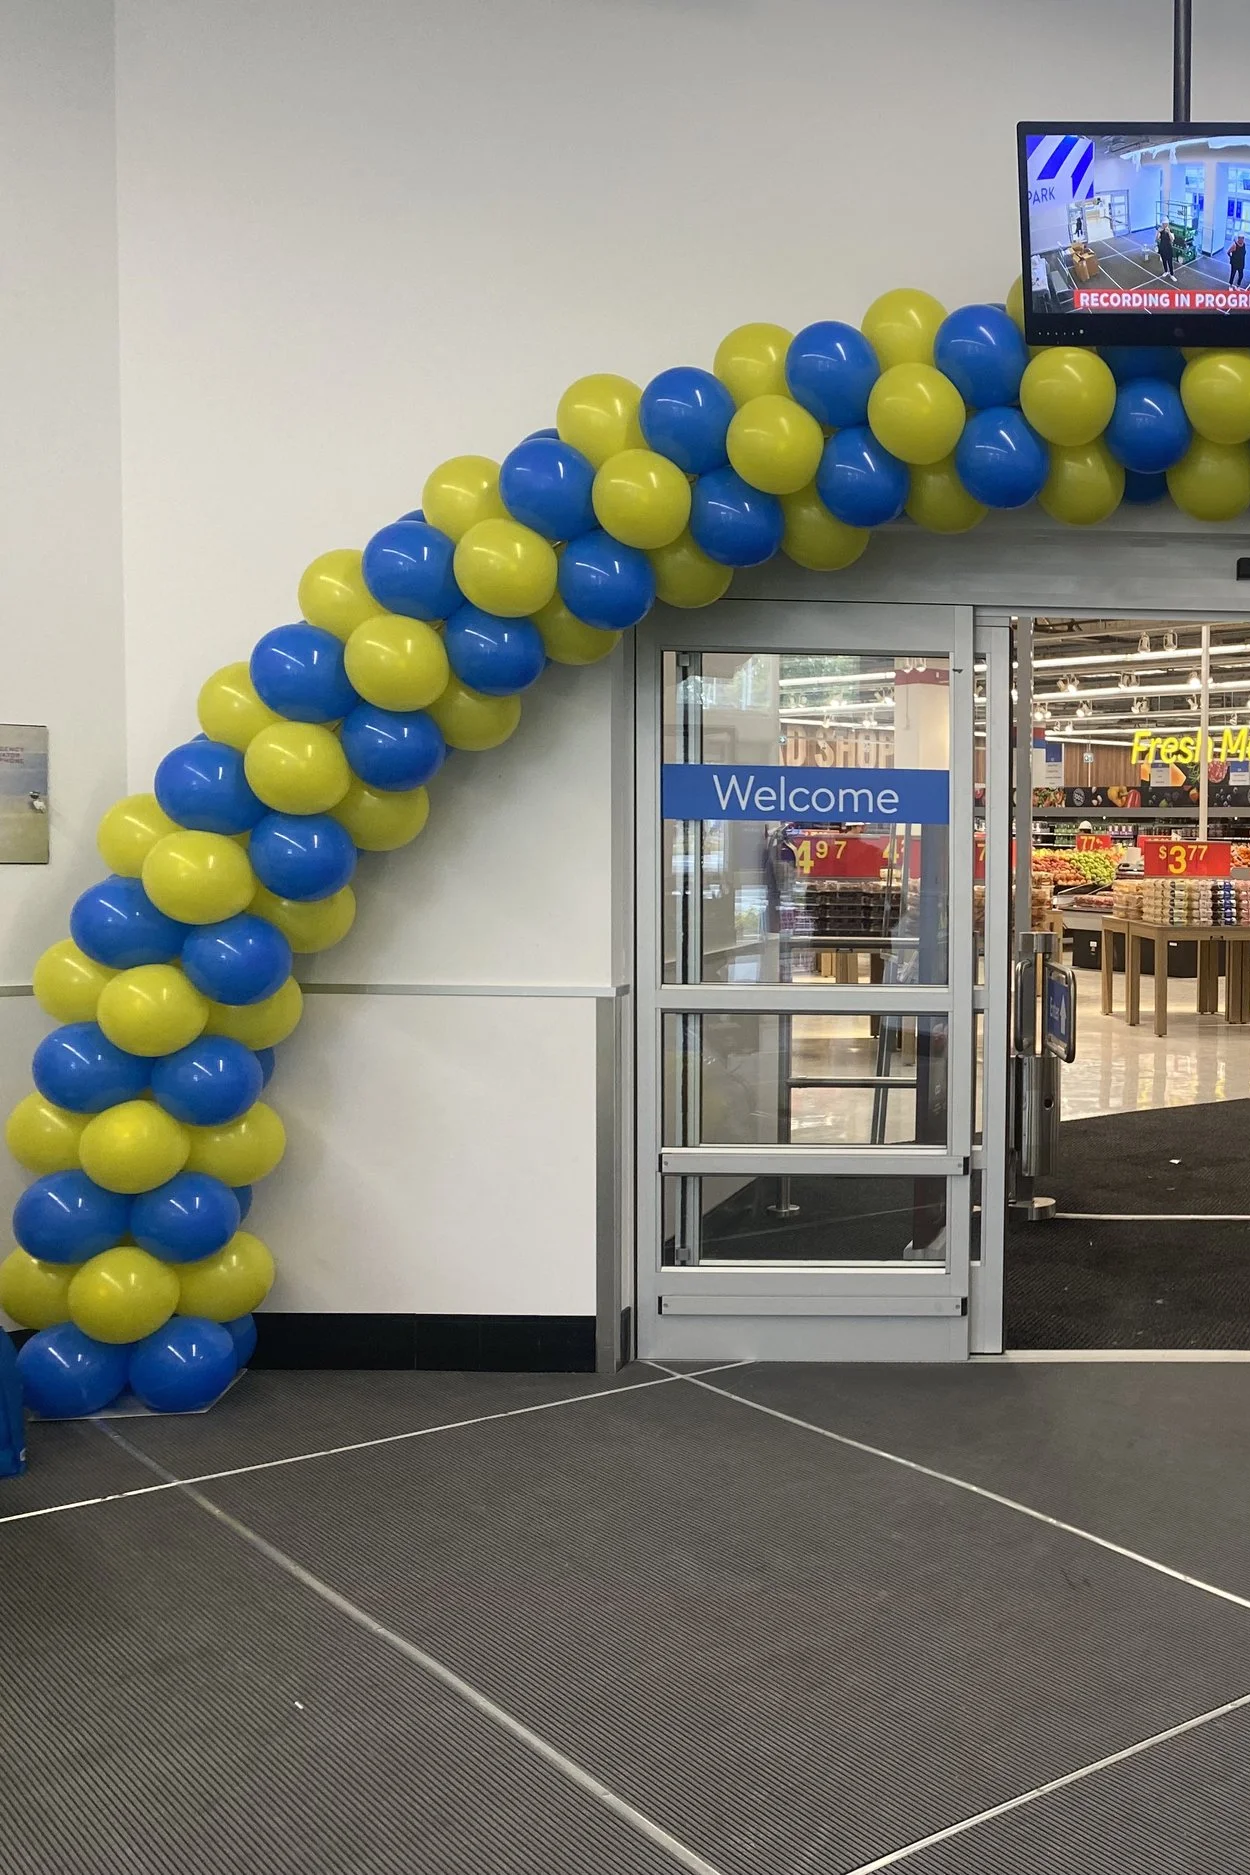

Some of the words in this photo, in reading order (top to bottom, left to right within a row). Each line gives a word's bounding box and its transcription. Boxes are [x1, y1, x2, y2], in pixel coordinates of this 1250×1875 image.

[1080, 293, 1170, 308] RECORDING
[1175, 294, 1190, 307] IN
[1131, 727, 1214, 764] Fresh
[712, 774, 899, 814] Welcome
[796, 840, 847, 874] 497
